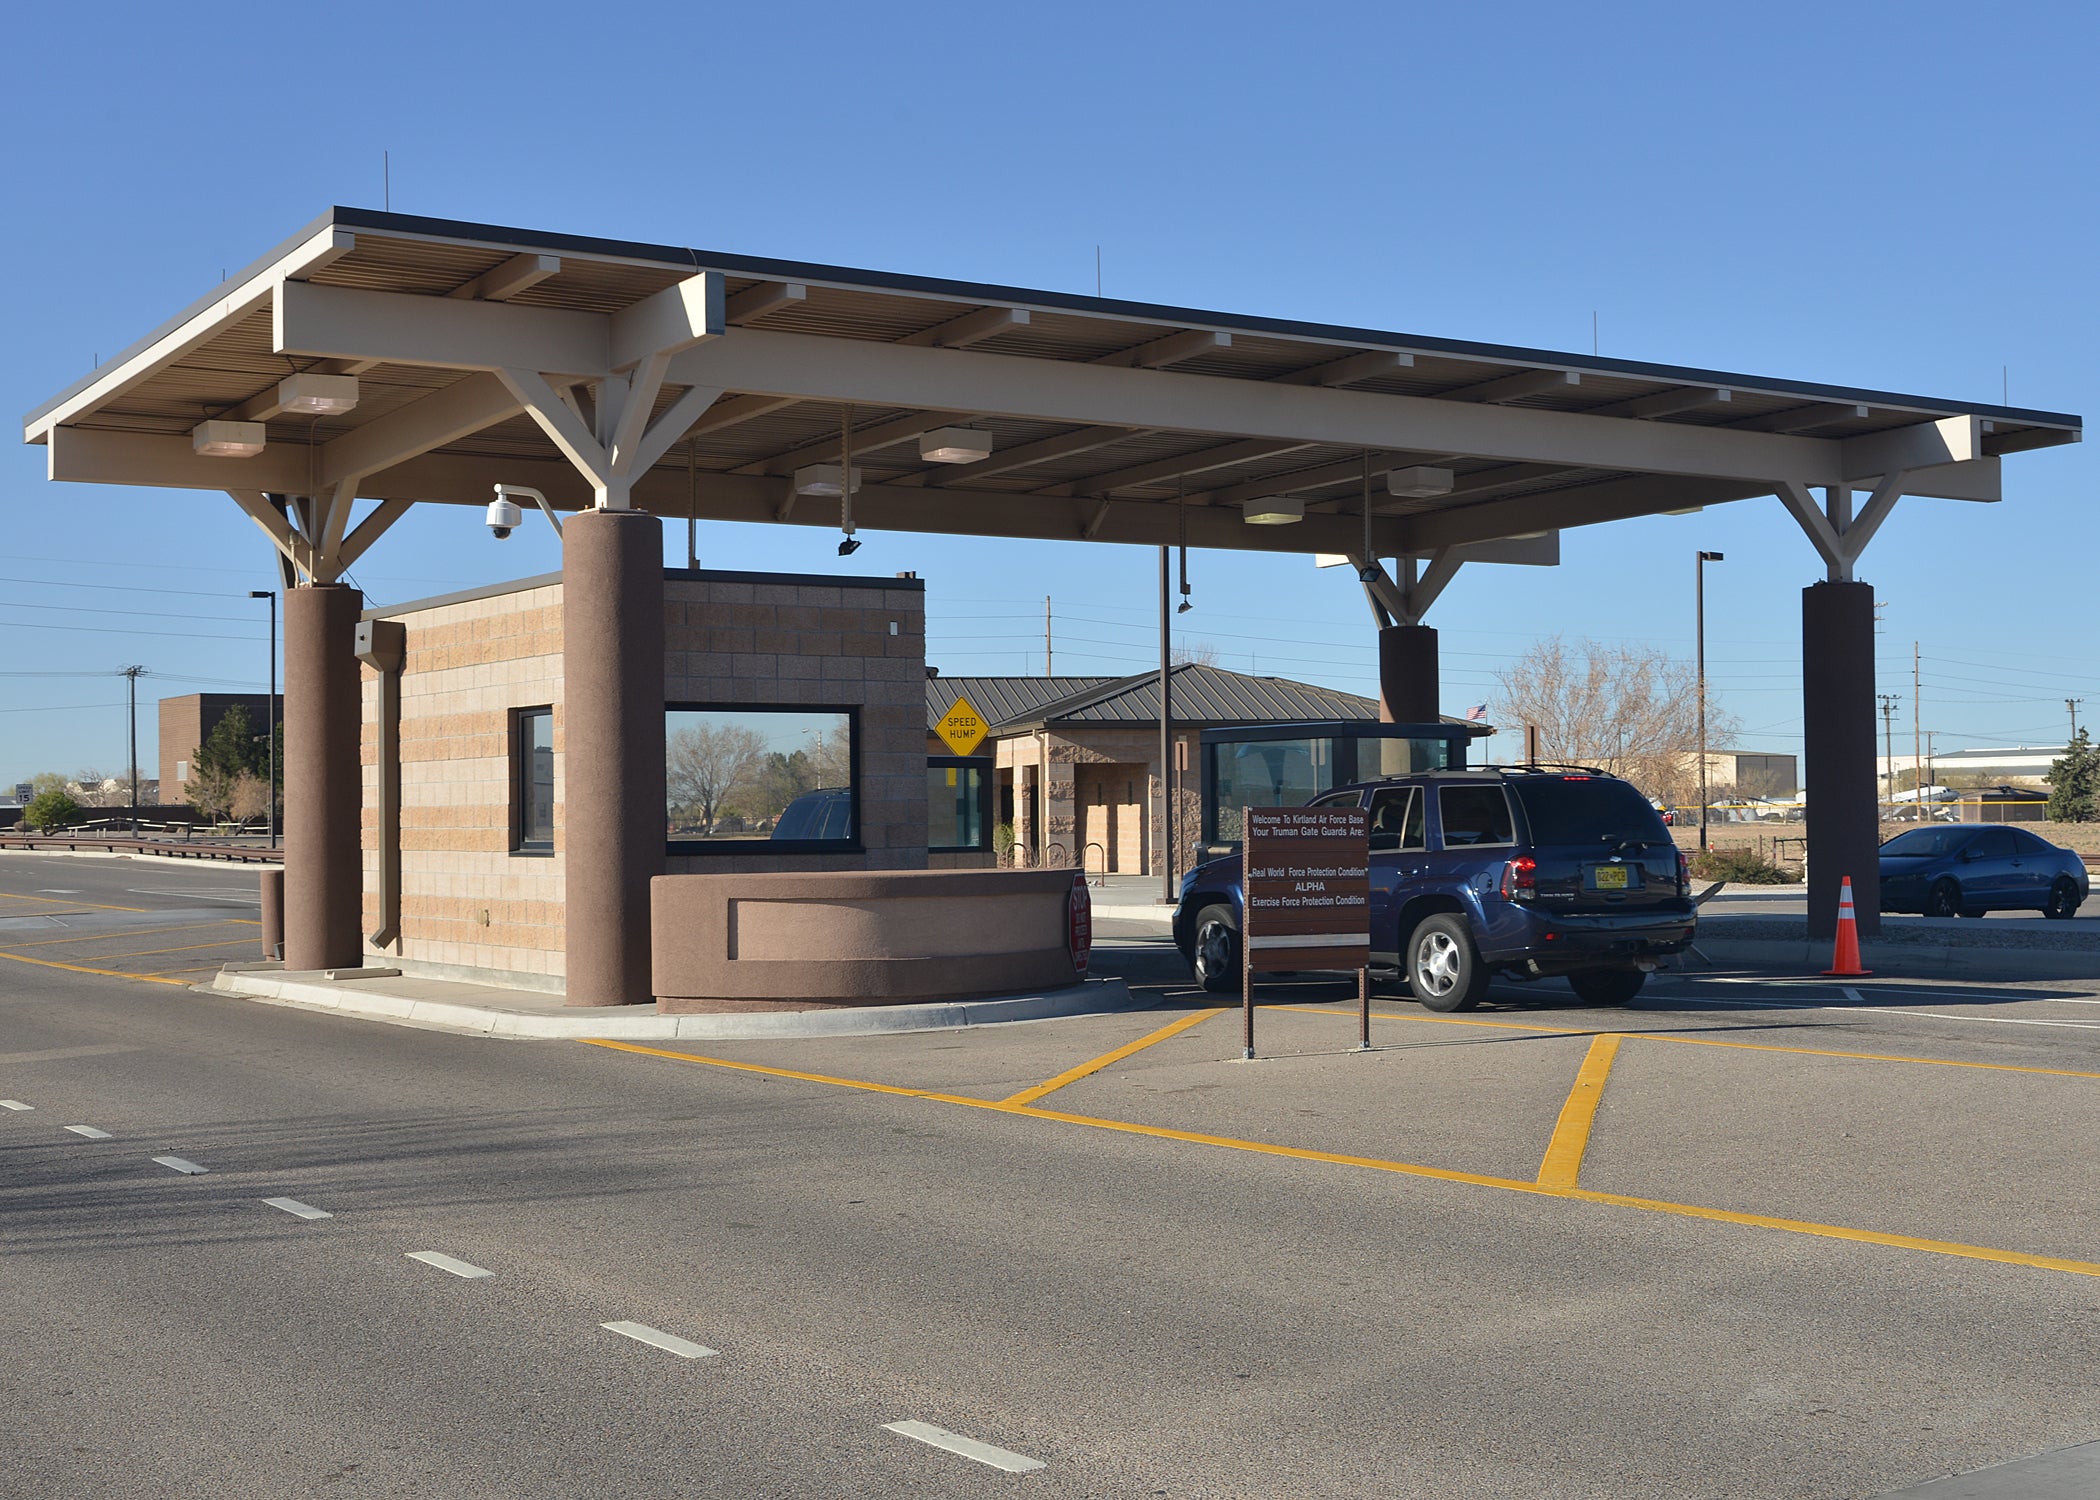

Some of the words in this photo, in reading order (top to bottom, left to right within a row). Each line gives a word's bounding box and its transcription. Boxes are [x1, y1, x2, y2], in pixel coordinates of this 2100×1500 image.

[948, 718, 976, 726] SPEED
[950, 730, 976, 738] HUMP
[1252, 815, 1280, 824] Welcome
[1283, 815, 1290, 824] To
[1293, 815, 1316, 824] Kirtland
[1319, 815, 1327, 823] Air
[1329, 815, 1346, 823] Force
[1349, 815, 1364, 824] Base
[1253, 827, 1268, 836] Your
[1273, 827, 1298, 836] Truman
[1301, 827, 1318, 836] Gate
[1322, 827, 1346, 836] Guards
[1349, 827, 1364, 836] Are:
[1252, 868, 1265, 877] Real
[1268, 868, 1284, 877] World
[1289, 868, 1305, 876] Force
[1307, 868, 1336, 876] Protection
[1338, 867, 1365, 876] Condition
[1295, 882, 1325, 891] ALPHA
[1073, 886, 1088, 910] STOP
[1252, 897, 1279, 906] Exercise
[1282, 897, 1300, 906] Force
[1302, 897, 1334, 905] Protection
[1336, 896, 1364, 905] Condition
